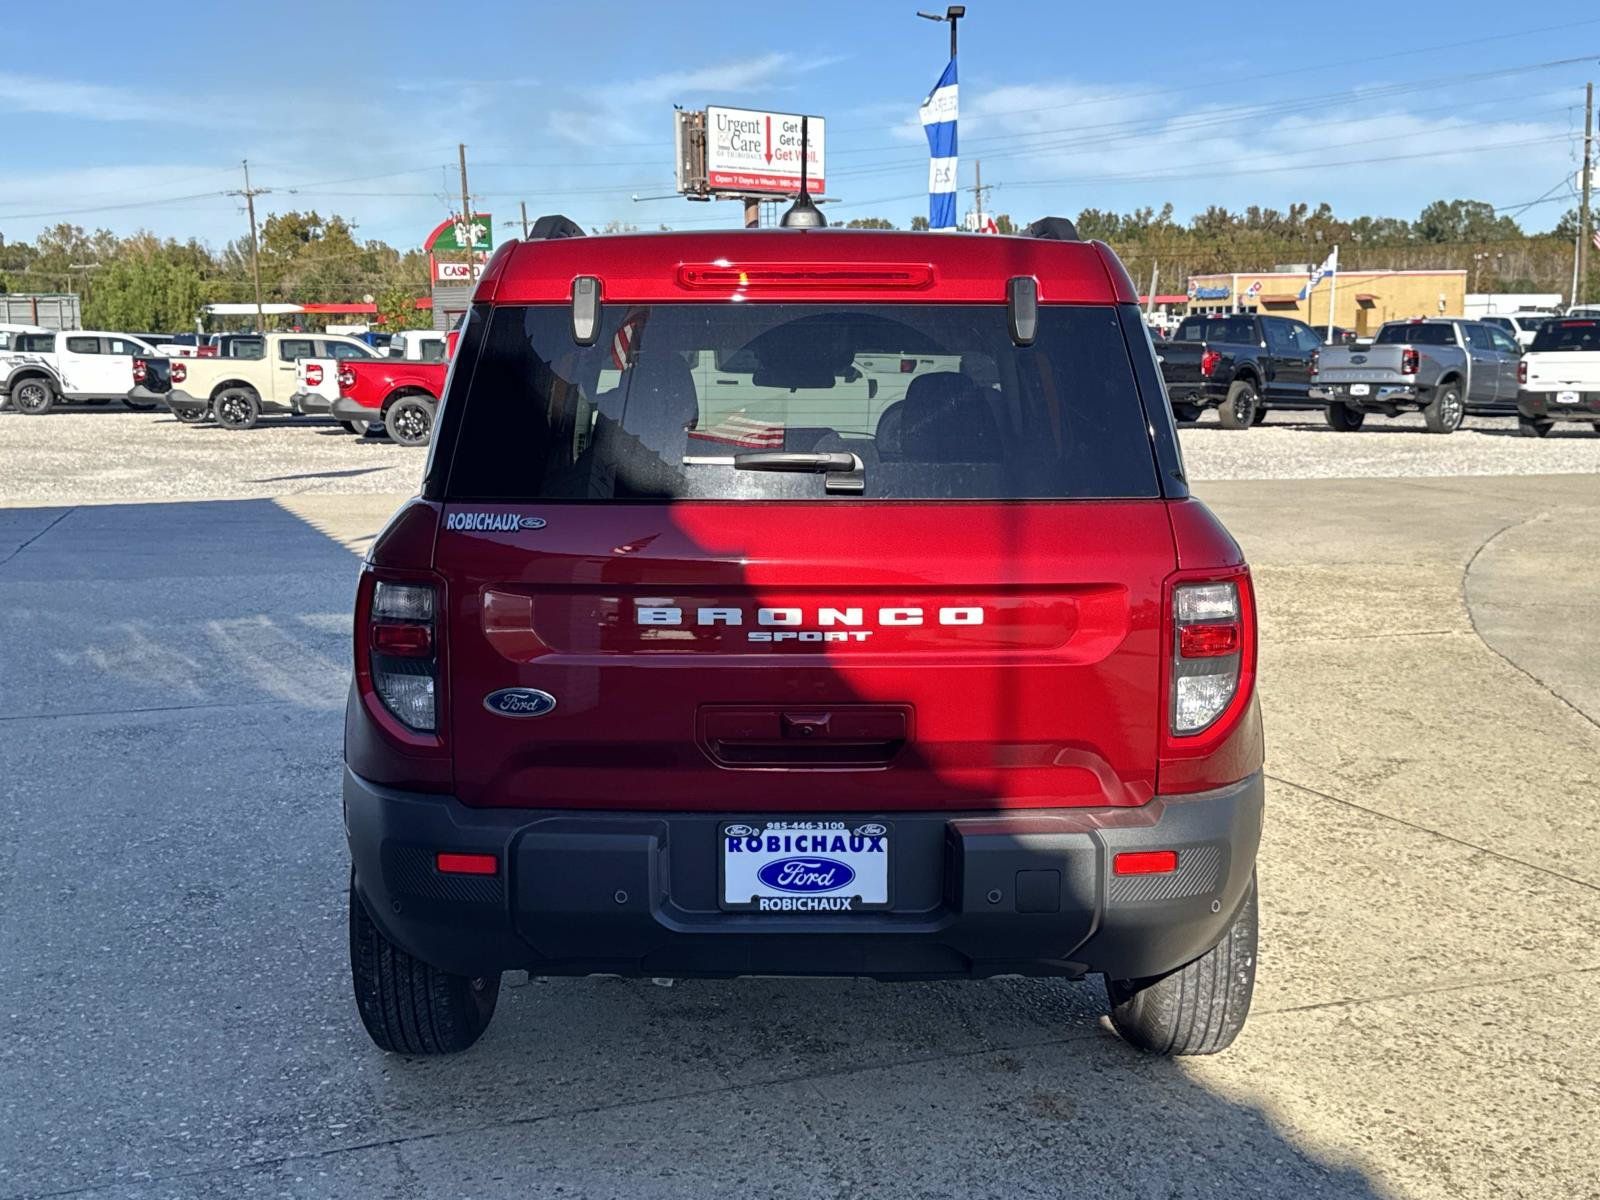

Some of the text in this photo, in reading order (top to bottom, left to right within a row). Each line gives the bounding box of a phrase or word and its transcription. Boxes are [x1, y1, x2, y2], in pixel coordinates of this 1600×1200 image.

[716, 114, 760, 138] Urgent
[783, 121, 798, 133] Get
[731, 134, 761, 152] Care
[780, 134, 795, 146] Get
[775, 148, 793, 161] Get
[715, 175, 733, 184] Open
[447, 513, 520, 531] ROBICHAUX
[637, 607, 984, 626] BRONCO
[748, 631, 874, 642] SPORT
[500, 693, 539, 711] Ford
[766, 822, 846, 830] 985-446-3100
[728, 835, 884, 853] ROBICHAUX
[777, 860, 836, 886] Ford
[759, 898, 852, 911] ROBICHAUX
